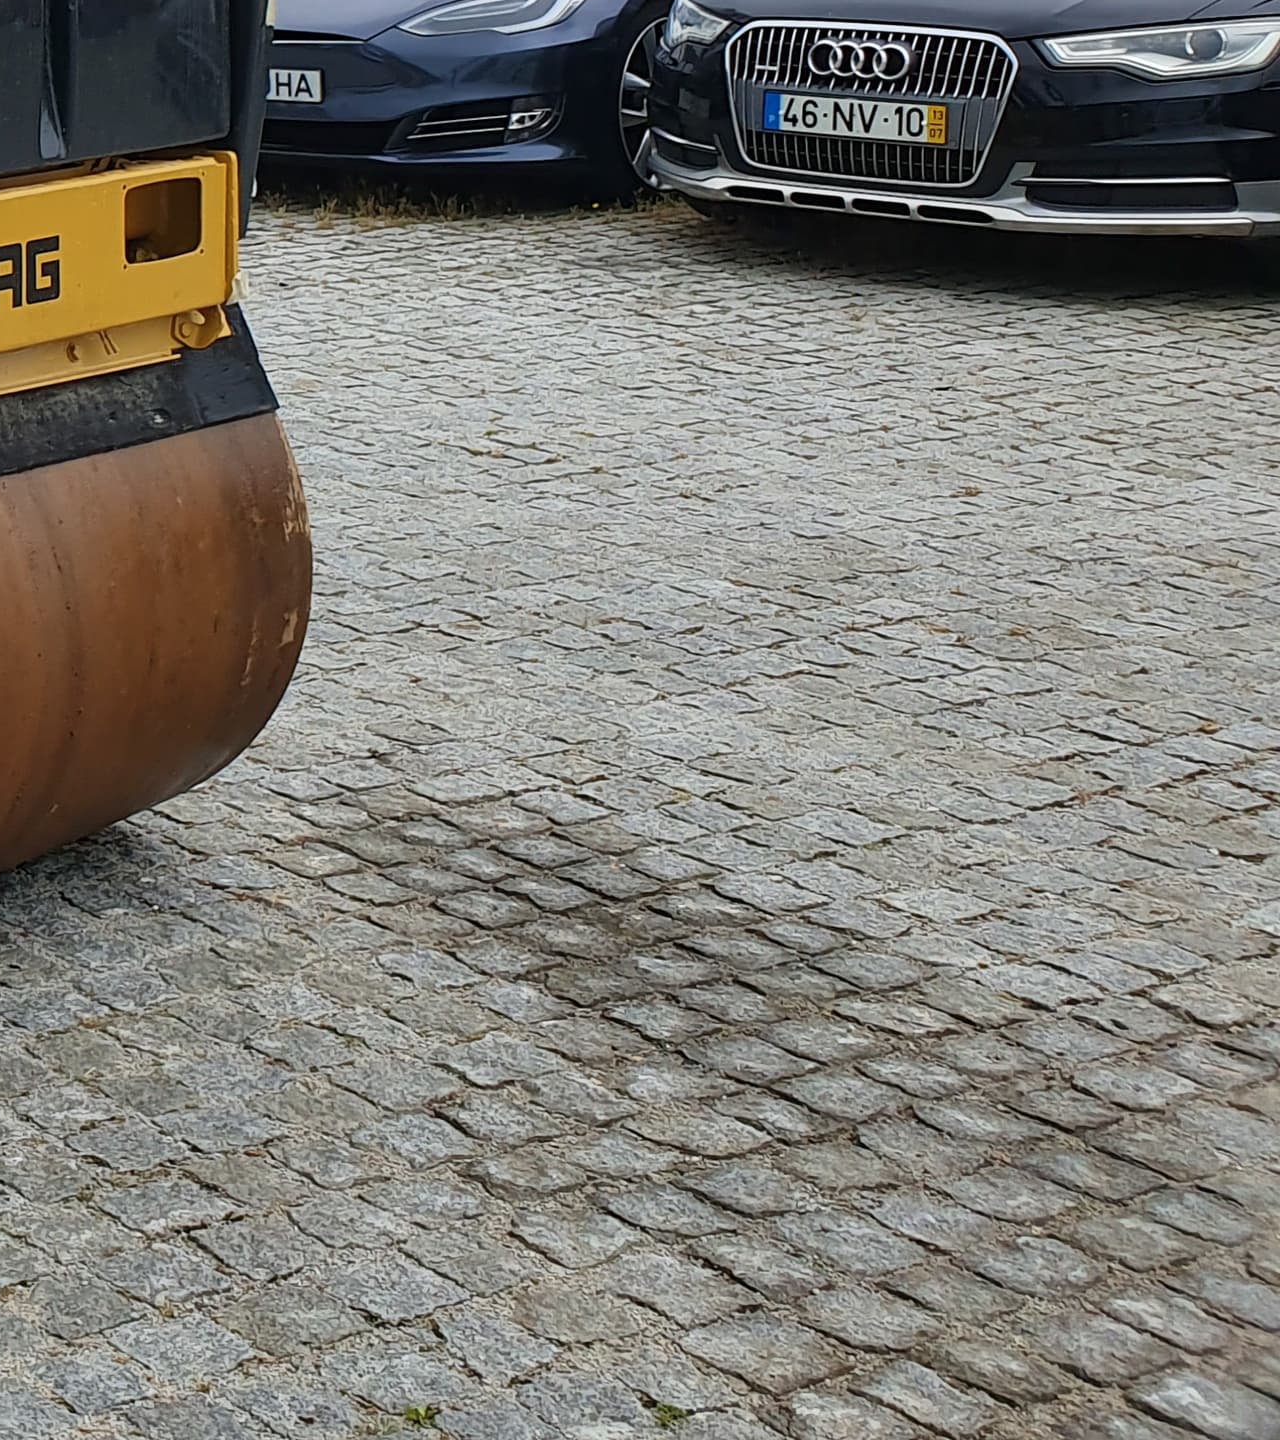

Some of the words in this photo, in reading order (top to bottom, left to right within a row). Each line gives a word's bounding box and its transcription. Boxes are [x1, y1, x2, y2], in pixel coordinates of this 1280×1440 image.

[275, 72, 313, 98] HA
[932, 110, 943, 121] 13
[929, 129, 943, 139] 07
